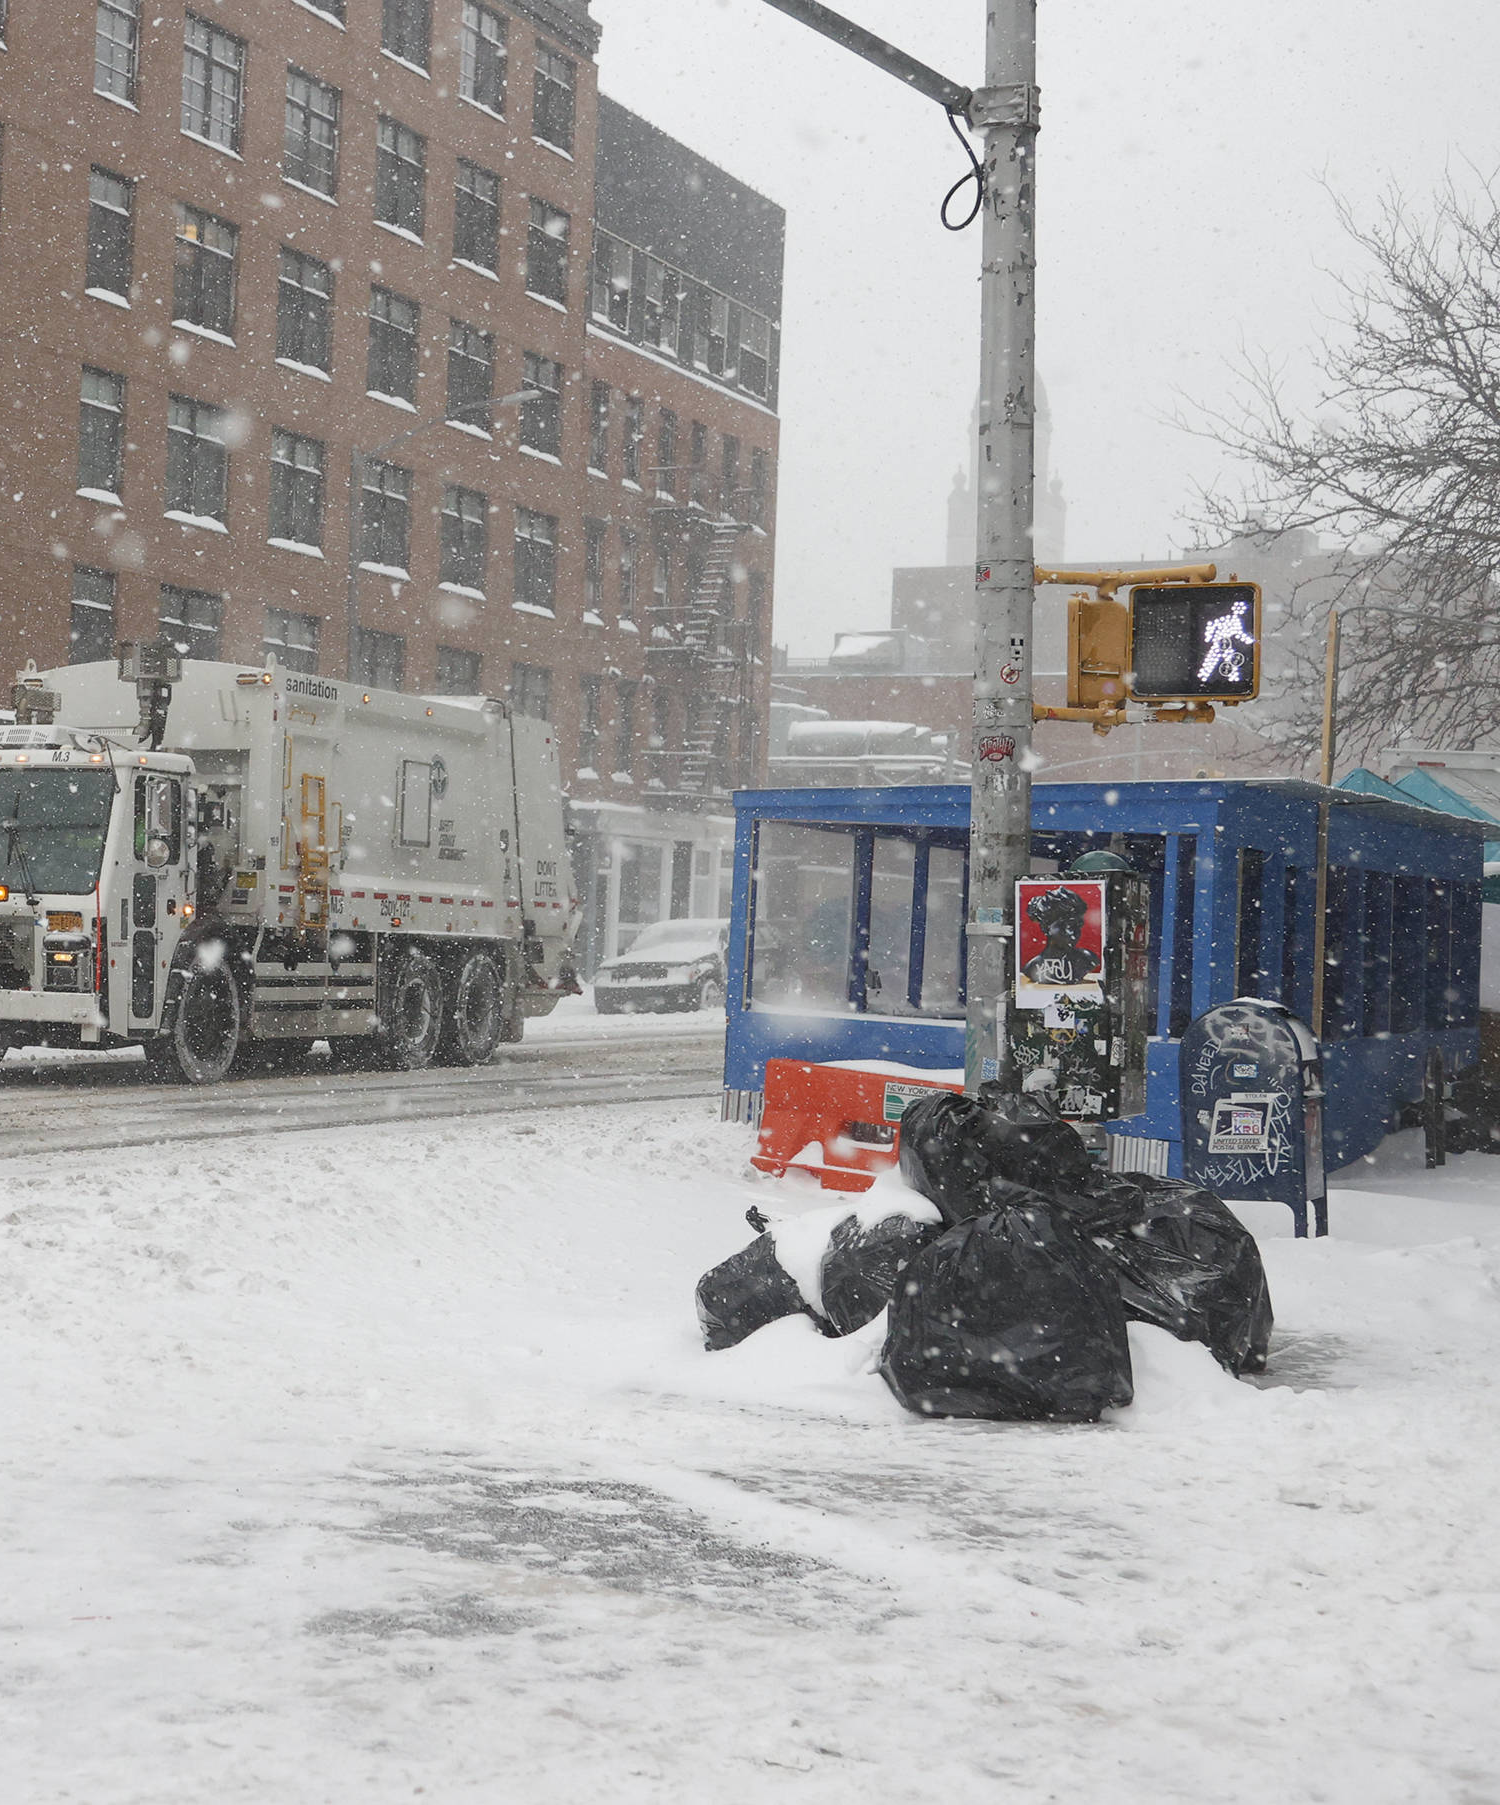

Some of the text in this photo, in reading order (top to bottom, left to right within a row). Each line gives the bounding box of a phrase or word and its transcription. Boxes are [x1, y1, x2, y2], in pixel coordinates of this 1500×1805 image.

[286, 678, 338, 701] sanitation
[52, 751, 71, 762] M.3
[887, 1083, 905, 1092] NEW
[908, 1087, 927, 1095] YORK
